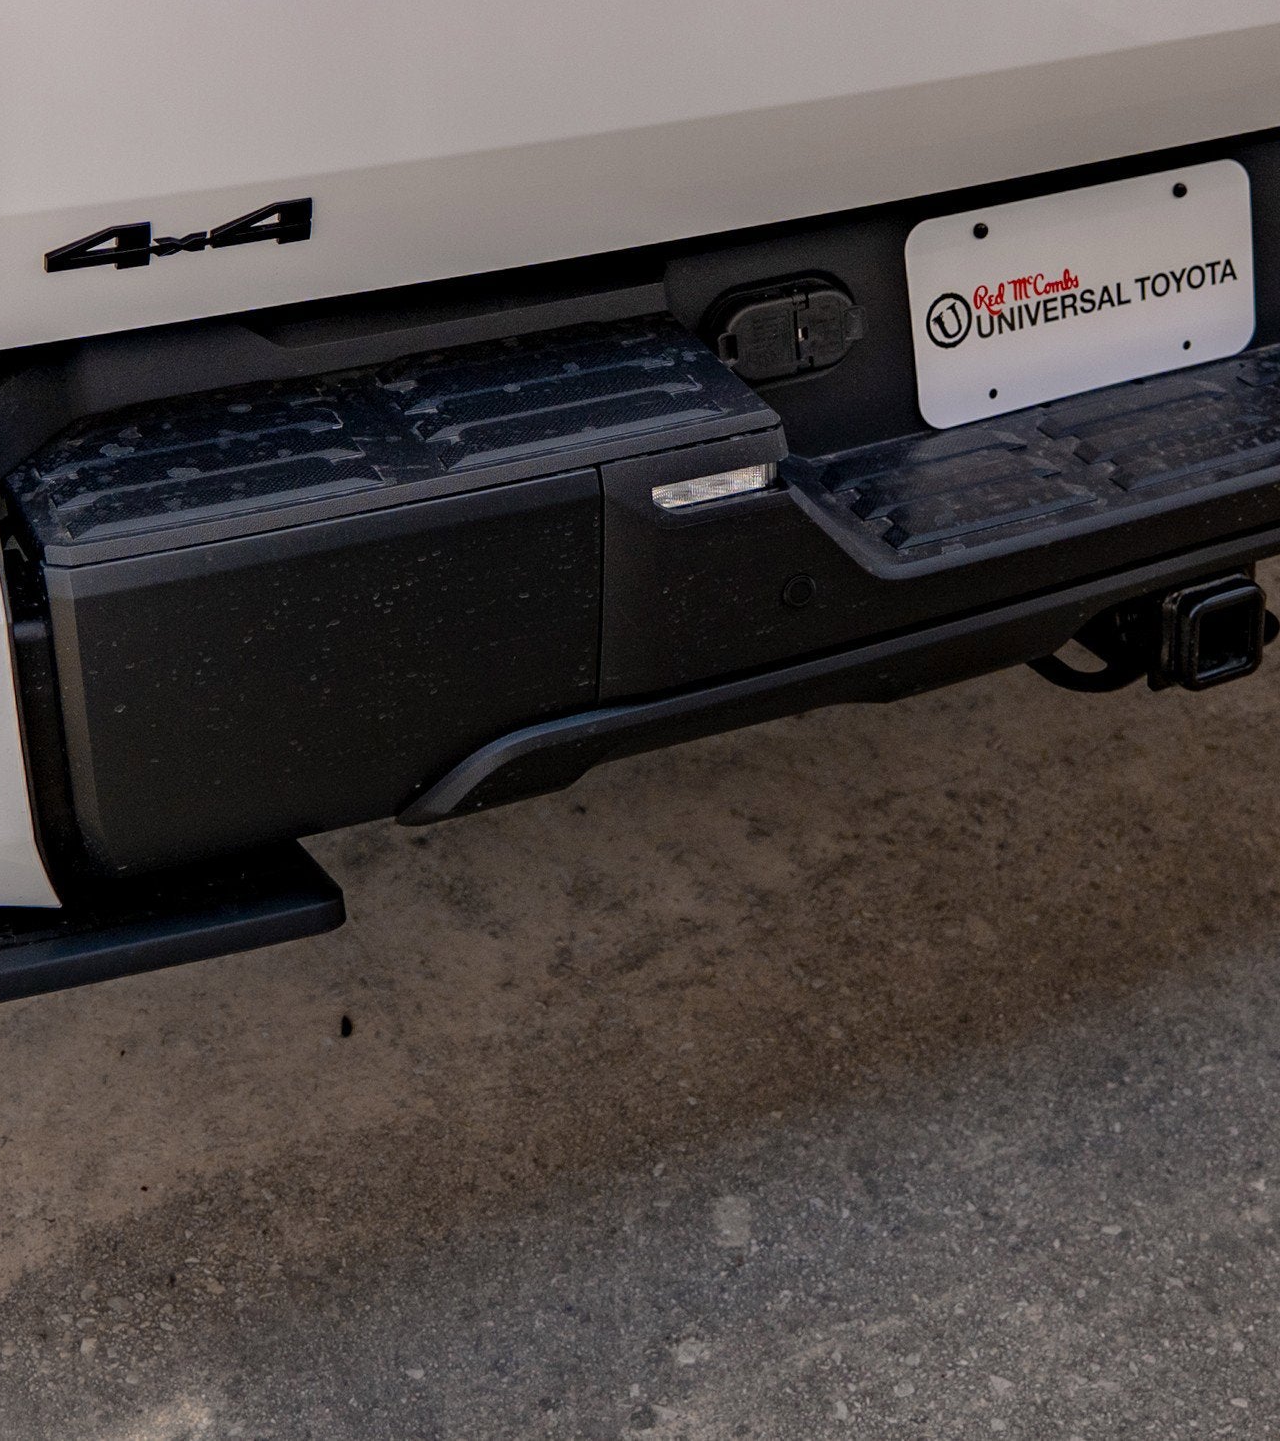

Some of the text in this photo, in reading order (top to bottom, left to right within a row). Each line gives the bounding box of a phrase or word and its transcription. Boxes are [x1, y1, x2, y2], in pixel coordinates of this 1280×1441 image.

[973, 282, 1006, 316] Red
[976, 259, 1237, 338] UNIVERSAL TOYOTA
